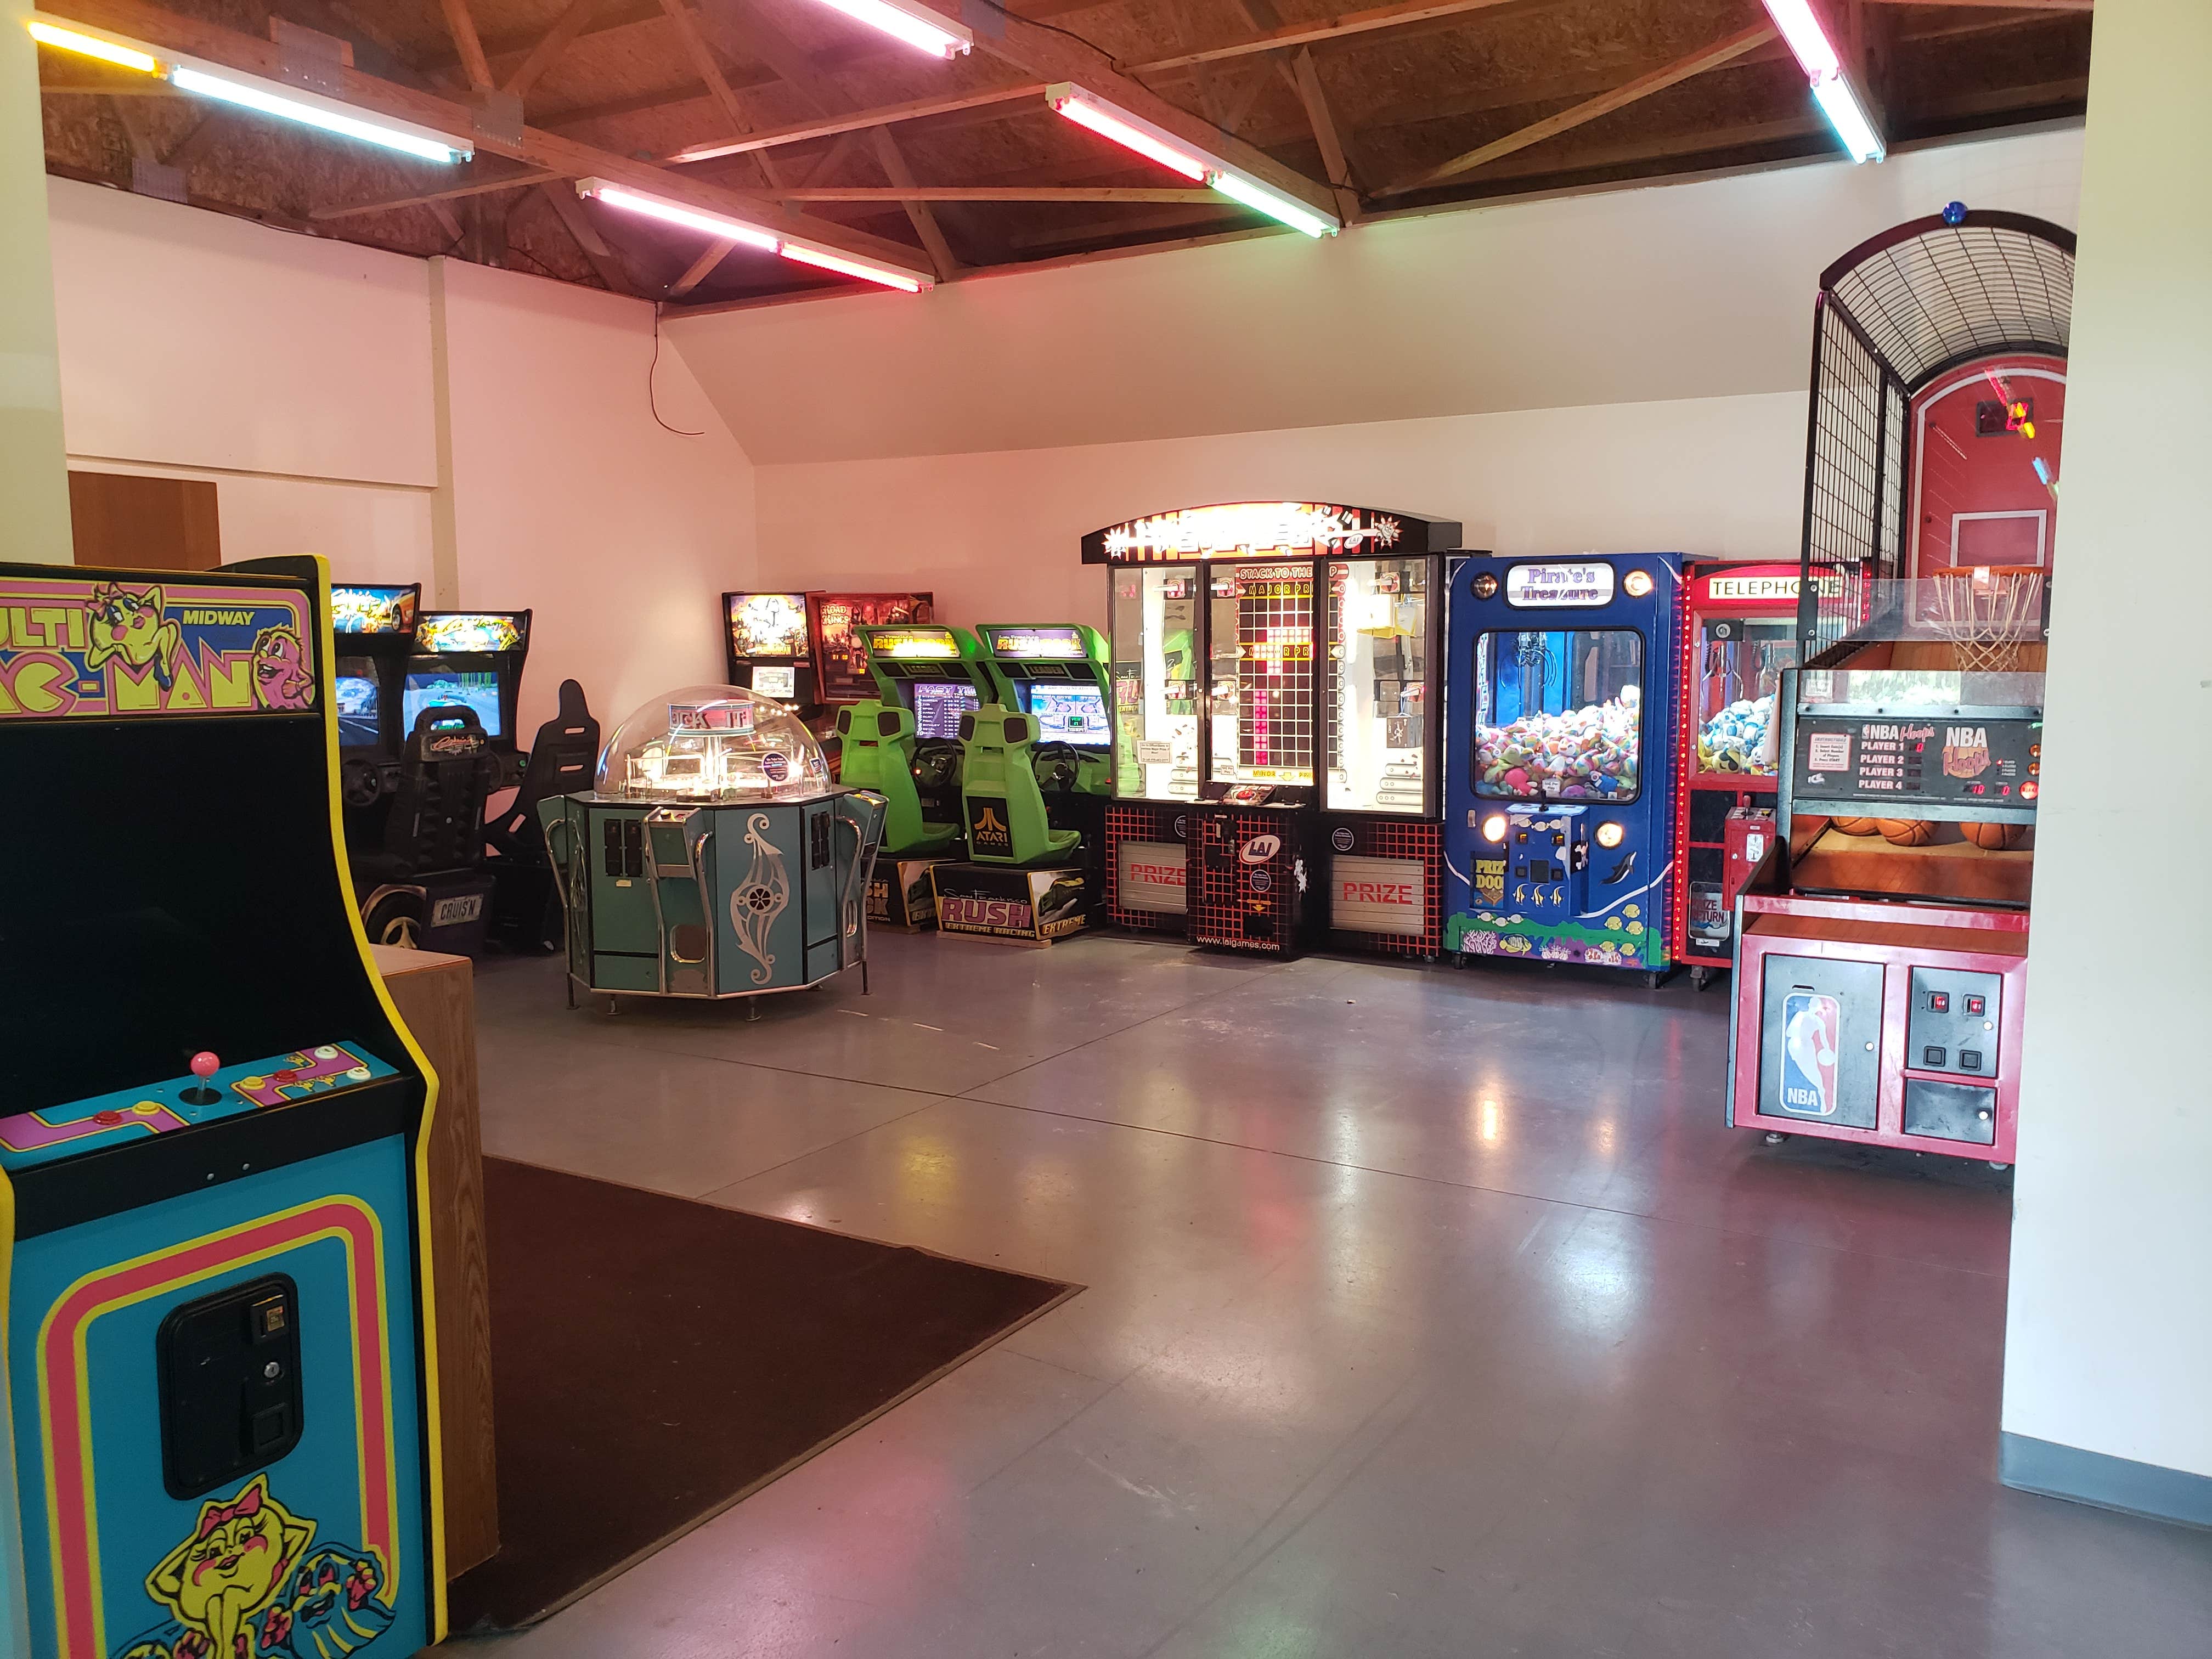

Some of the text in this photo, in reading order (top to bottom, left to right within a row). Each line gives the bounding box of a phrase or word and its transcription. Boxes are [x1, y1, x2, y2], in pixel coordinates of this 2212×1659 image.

[1240, 567, 1313, 579] STACK TO THE
[1248, 585, 1291, 595] MAJOR
[822, 605, 847, 615] ROAD
[182, 609, 256, 627] MIDWAY
[822, 614, 849, 625] KINGS
[1870, 724, 1899, 740] NBA
[1946, 726, 1988, 748] NBA
[1861, 741, 1897, 751] PLAYER
[1899, 742, 1904, 751] 1
[1860, 754, 1904, 764] PLAYER 2
[1859, 767, 1903, 777] PLAYER 3
[1858, 780, 1903, 790] PLAYER 4
[976, 831, 1008, 843] ATARI
[1248, 841, 1272, 856] LAI
[1475, 859, 1504, 874] PRIZ
[1131, 864, 1186, 886] PRIZE
[1476, 874, 1503, 890] DOO
[1343, 882, 1413, 905] PRIZE
[439, 898, 477, 920] CRUIS'N
[941, 898, 1034, 928] RUSH
[945, 922, 1035, 938] EXTREME RACING
[1043, 915, 1086, 935] EXTREME
[1196, 936, 1280, 951] www.laigames.com
[1787, 1087, 1818, 1107] NBA
